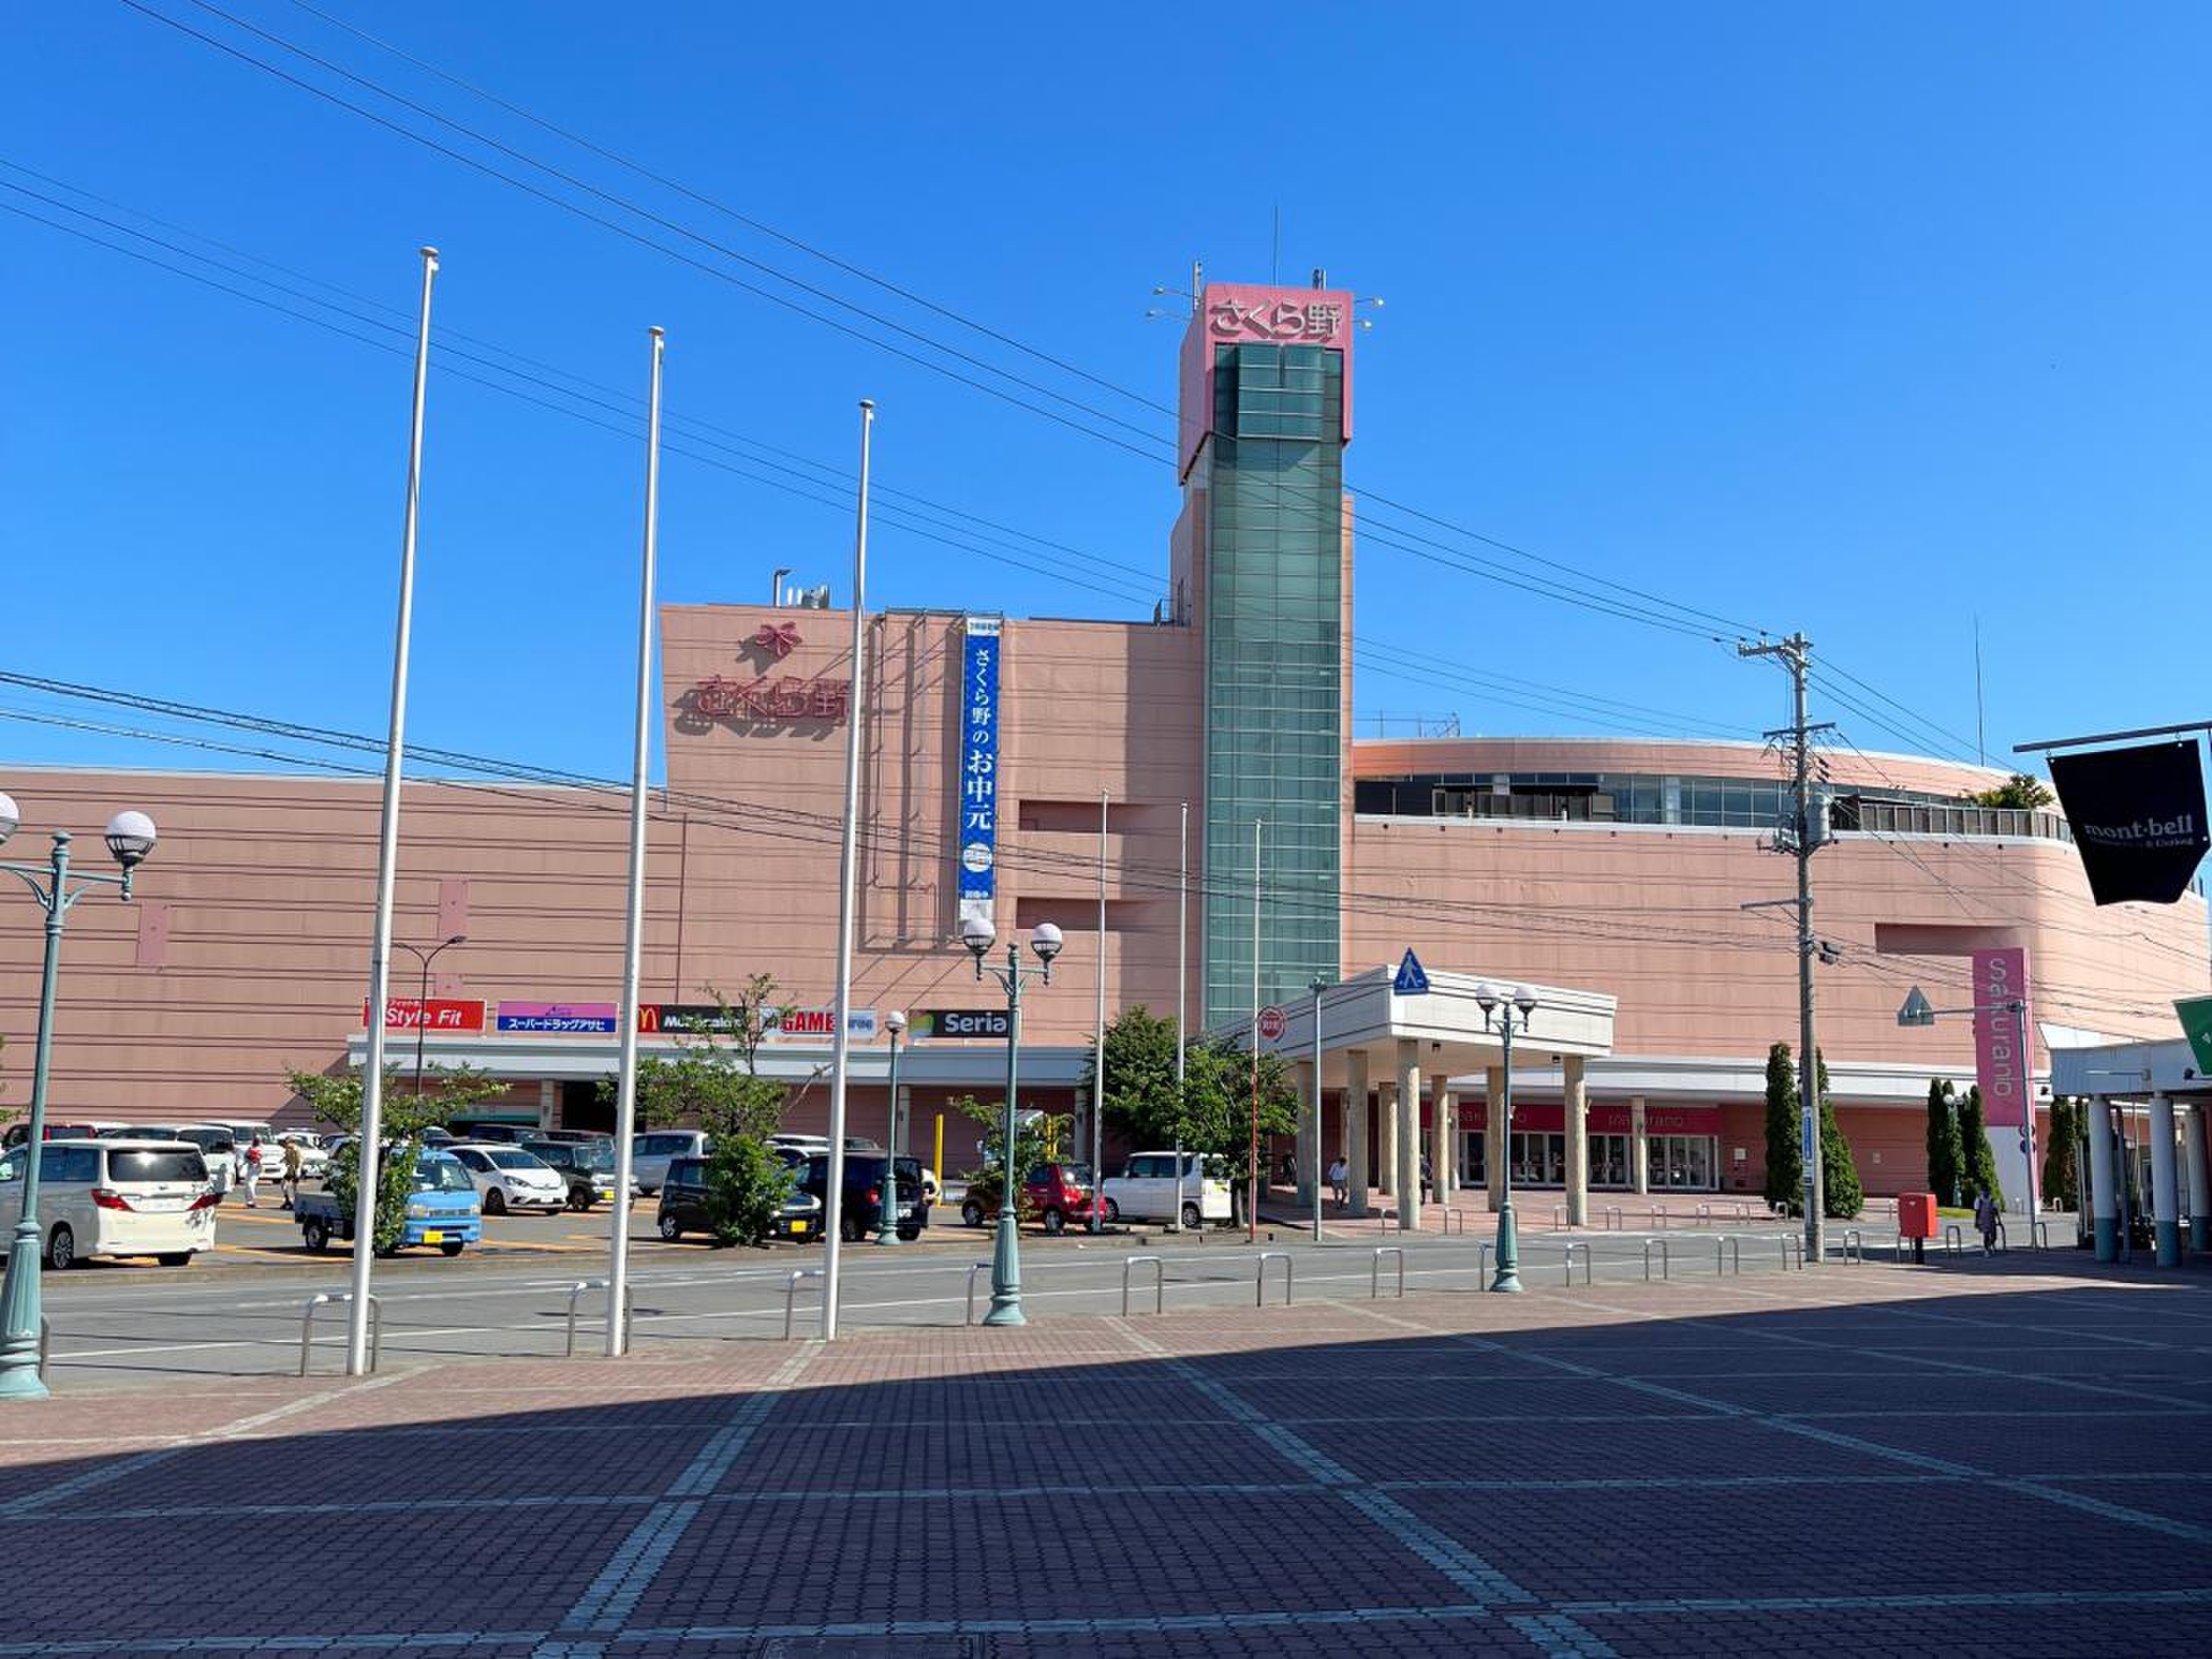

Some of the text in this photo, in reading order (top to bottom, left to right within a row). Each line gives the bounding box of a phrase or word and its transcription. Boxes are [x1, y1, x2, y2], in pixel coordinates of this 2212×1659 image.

[1210, 299, 1343, 339] さくら野
[696, 675, 850, 726] さくら野
[966, 648, 994, 830] さくら野のお中元
[385, 1007, 463, 1028] Style Fit
[508, 1018, 606, 1031] スーパードラッグアサヒ
[944, 1012, 1007, 1033] Seria
